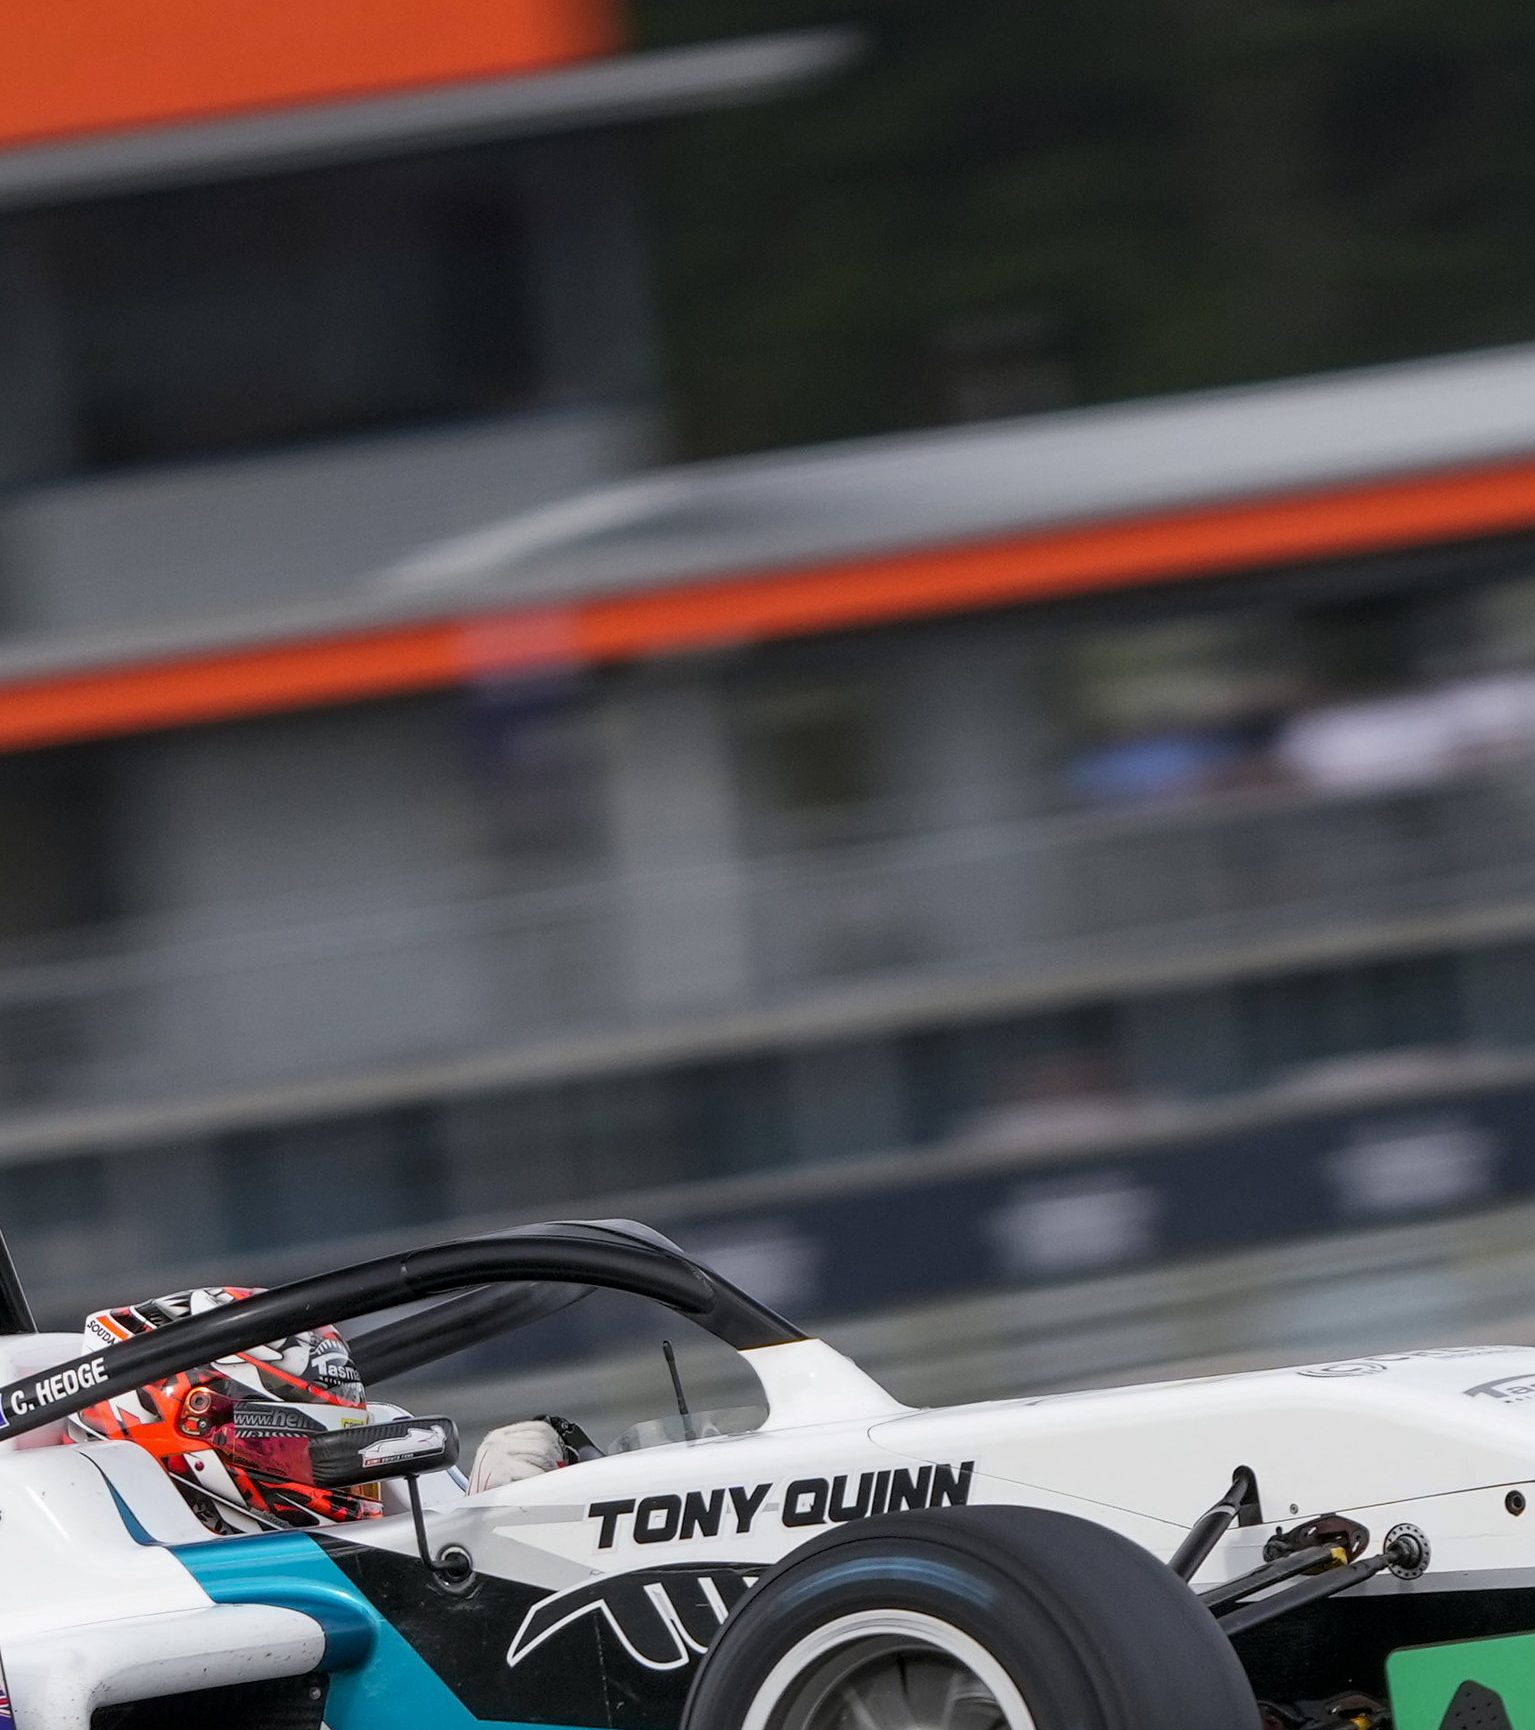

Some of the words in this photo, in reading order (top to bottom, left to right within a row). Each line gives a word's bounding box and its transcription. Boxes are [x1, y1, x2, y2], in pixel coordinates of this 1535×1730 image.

[10, 1390, 35, 1415] C.
[35, 1357, 109, 1407] HEDGE
[587, 1483, 774, 1548] TONY
[781, 1460, 974, 1527] QUINN
